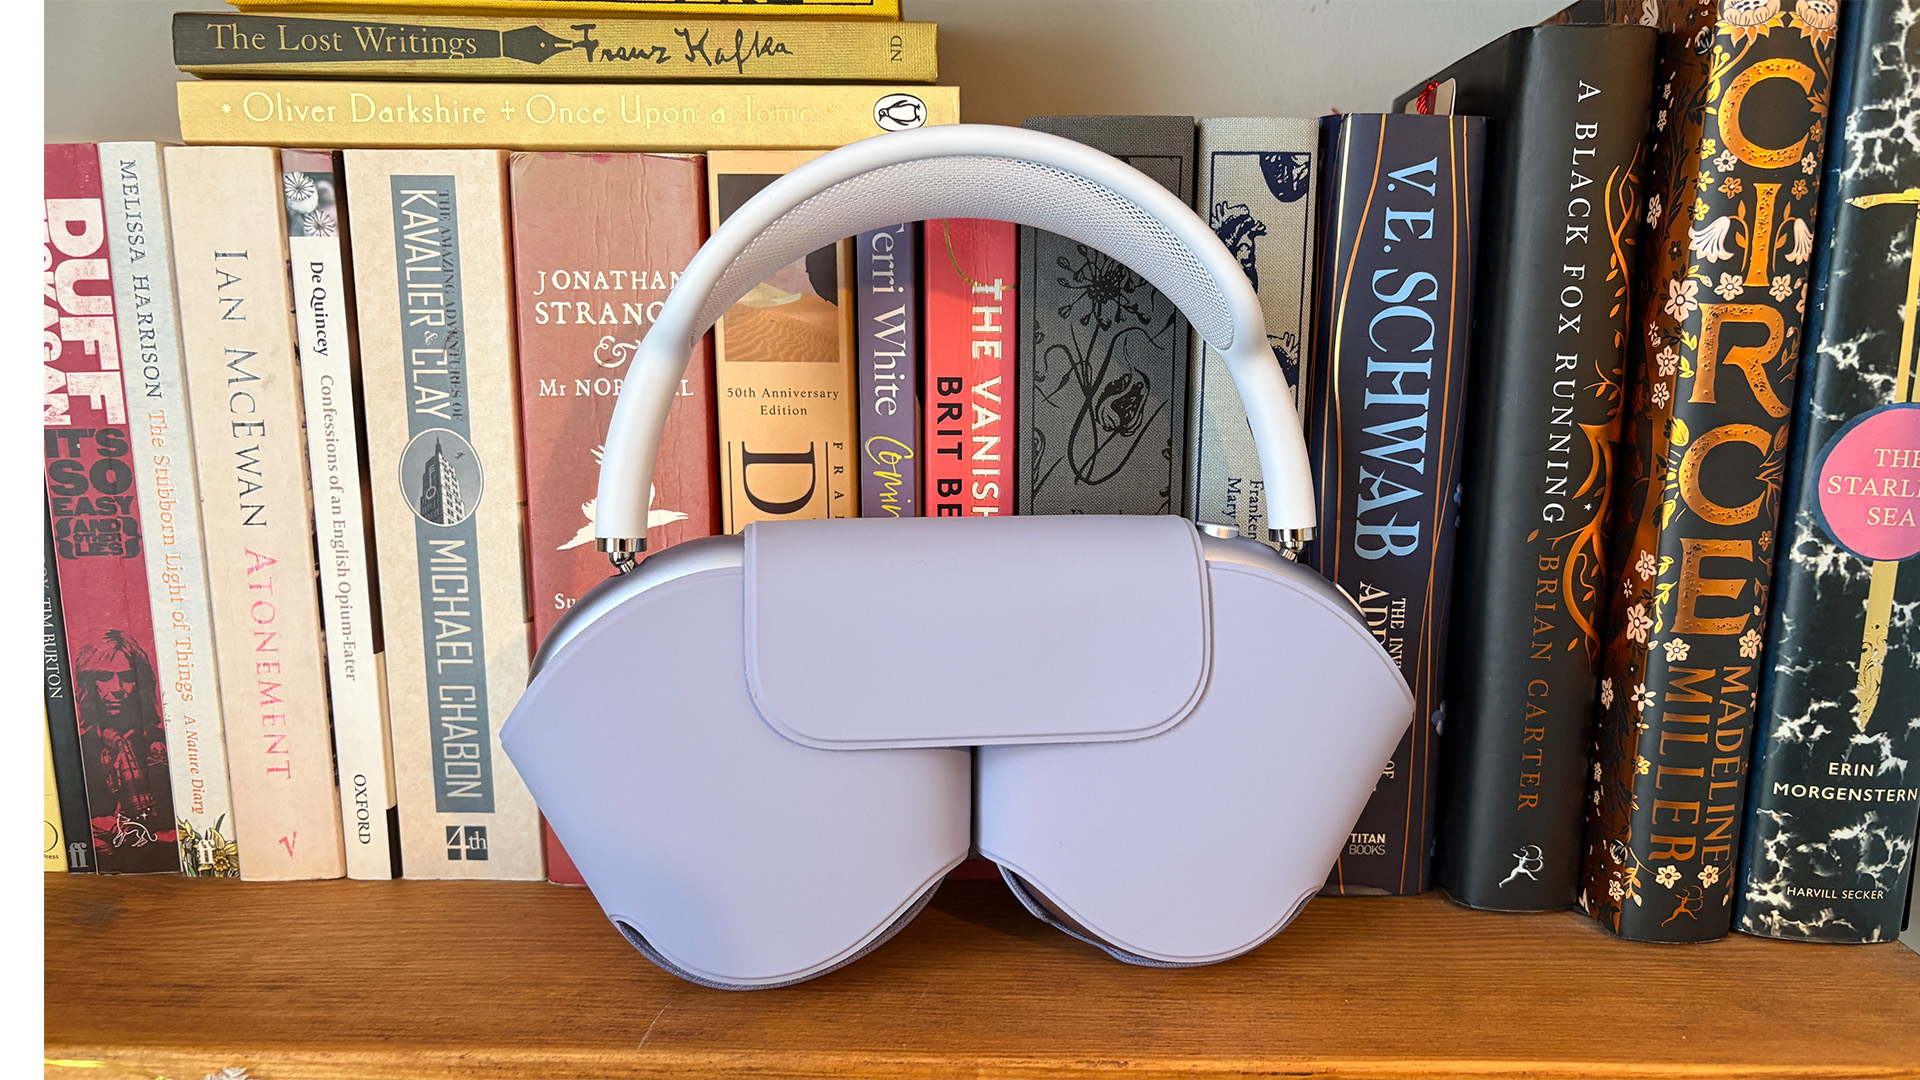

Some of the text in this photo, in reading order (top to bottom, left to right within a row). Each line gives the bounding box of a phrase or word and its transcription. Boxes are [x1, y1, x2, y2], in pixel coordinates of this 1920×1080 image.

[207, 22, 477, 60] The Lost Writings
[571, 23, 794, 74] Franz Kafka
[890, 34, 903, 62] ND
[242, 91, 487, 124] Oliver Darkshire
[525, 93, 606, 124] Once
[620, 95, 697, 128] Upon
[711, 109, 726, 124] a
[119, 159, 163, 399] MELISSA HARRISON
[214, 250, 249, 322] IAN
[400, 189, 452, 421] KAVALIER & CLAY
[438, 189, 463, 422] THE AMAZING ADVENTURES OF
[1542, 80, 1602, 524] A BLACK FOX RUNNING
[45, 198, 126, 424] DUFF
[310, 261, 329, 357] De Quincey
[972, 278, 1002, 359] THE
[594, 335, 641, 368] &
[873, 303, 907, 416] White
[1670, 58, 1816, 634] CIRCE
[539, 379, 567, 396] Mr
[727, 387, 840, 400] 50th Anniversary
[760, 405, 808, 416] Edition
[1354, 269, 1438, 560] SCHWAB
[44, 428, 129, 458] IT'S
[937, 377, 963, 460] BRIT
[48, 458, 133, 496] SO
[833, 442, 845, 519] FRA
[1222, 477, 1242, 519] Mary
[1827, 475, 1920, 498] STARL
[52, 496, 135, 517] EASY
[320, 374, 357, 682] Confessions of an English Opium-Eater
[1867, 507, 1916, 527] SEA
[149, 409, 193, 702] The Stubborn Light of Things
[1390, 598, 1406, 629] THE
[44, 633, 63, 699] BURTON
[245, 547, 291, 780] ATONEMENT
[429, 539, 483, 798] MICHAEL CHABON
[1516, 553, 1560, 811] BRIAN CARTER
[183, 714, 204, 815] A Nature Diary
[1648, 665, 1716, 861] MILLER
[1701, 665, 1752, 865] MADELINE
[1773, 782, 1918, 802] MORGENSTERN
[1828, 762, 1874, 777] ERIN
[354, 773, 371, 845] OXFORD
[69, 842, 89, 867] ff
[446, 825, 488, 860] 4th
[1349, 844, 1386, 856] BOOKS
[1350, 833, 1386, 844] TITAN
[1786, 886, 1884, 900] HARVILL SECKER
